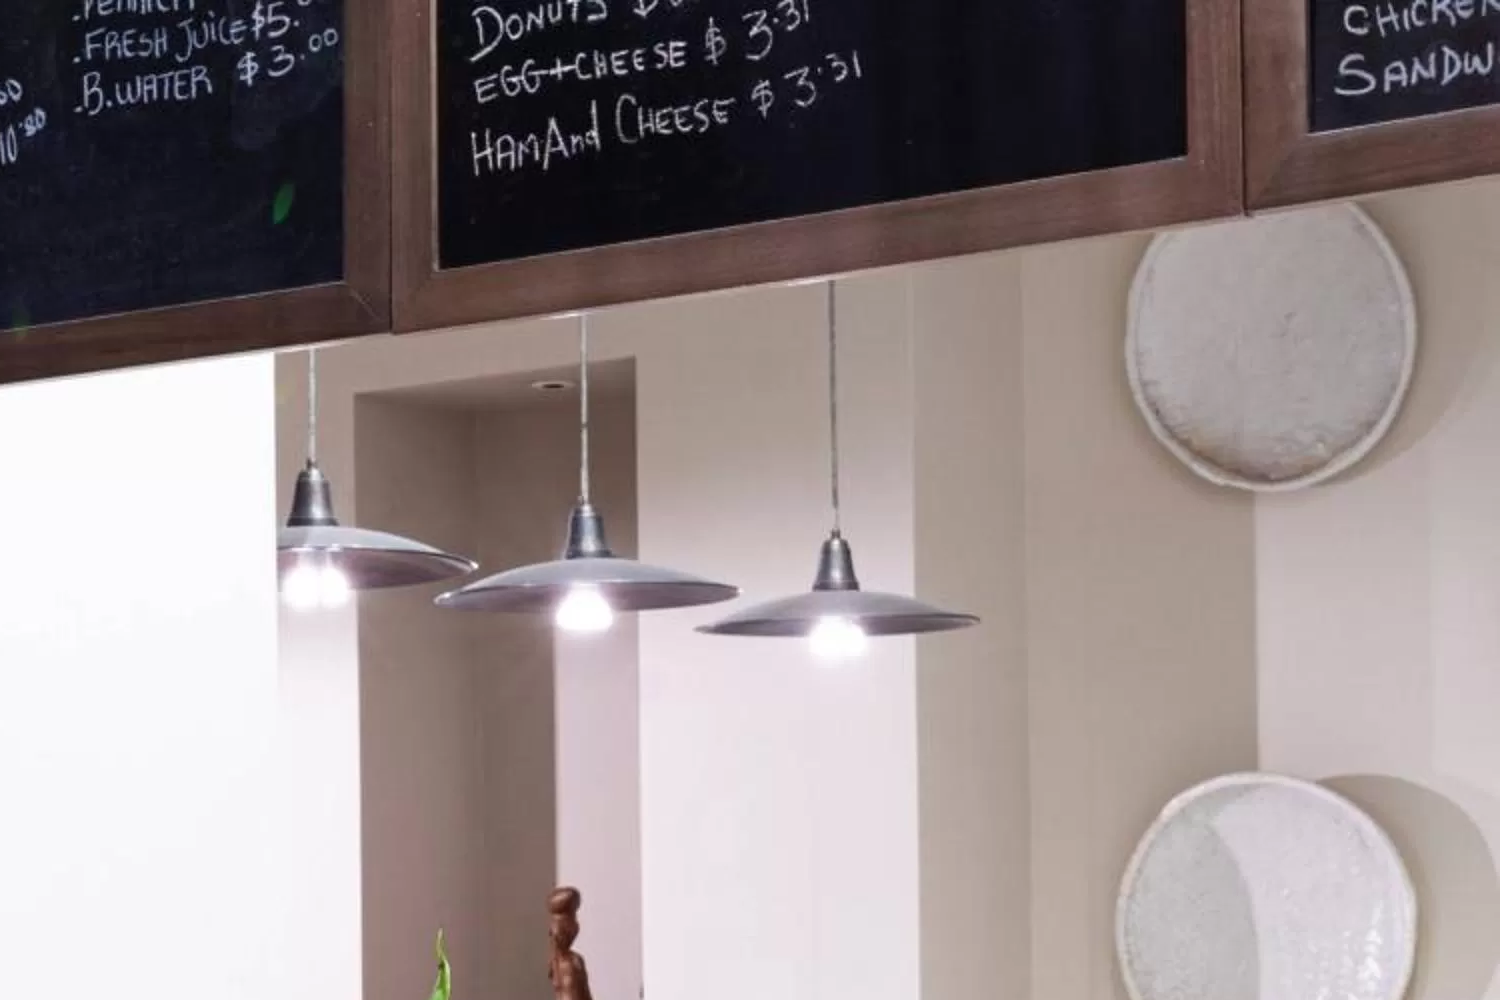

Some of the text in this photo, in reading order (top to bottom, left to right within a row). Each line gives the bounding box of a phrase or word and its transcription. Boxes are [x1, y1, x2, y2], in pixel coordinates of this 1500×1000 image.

[84, 26, 168, 61] FRESH
[1333, 41, 1500, 96] SANDW
[615, 93, 736, 144] CHEESE
